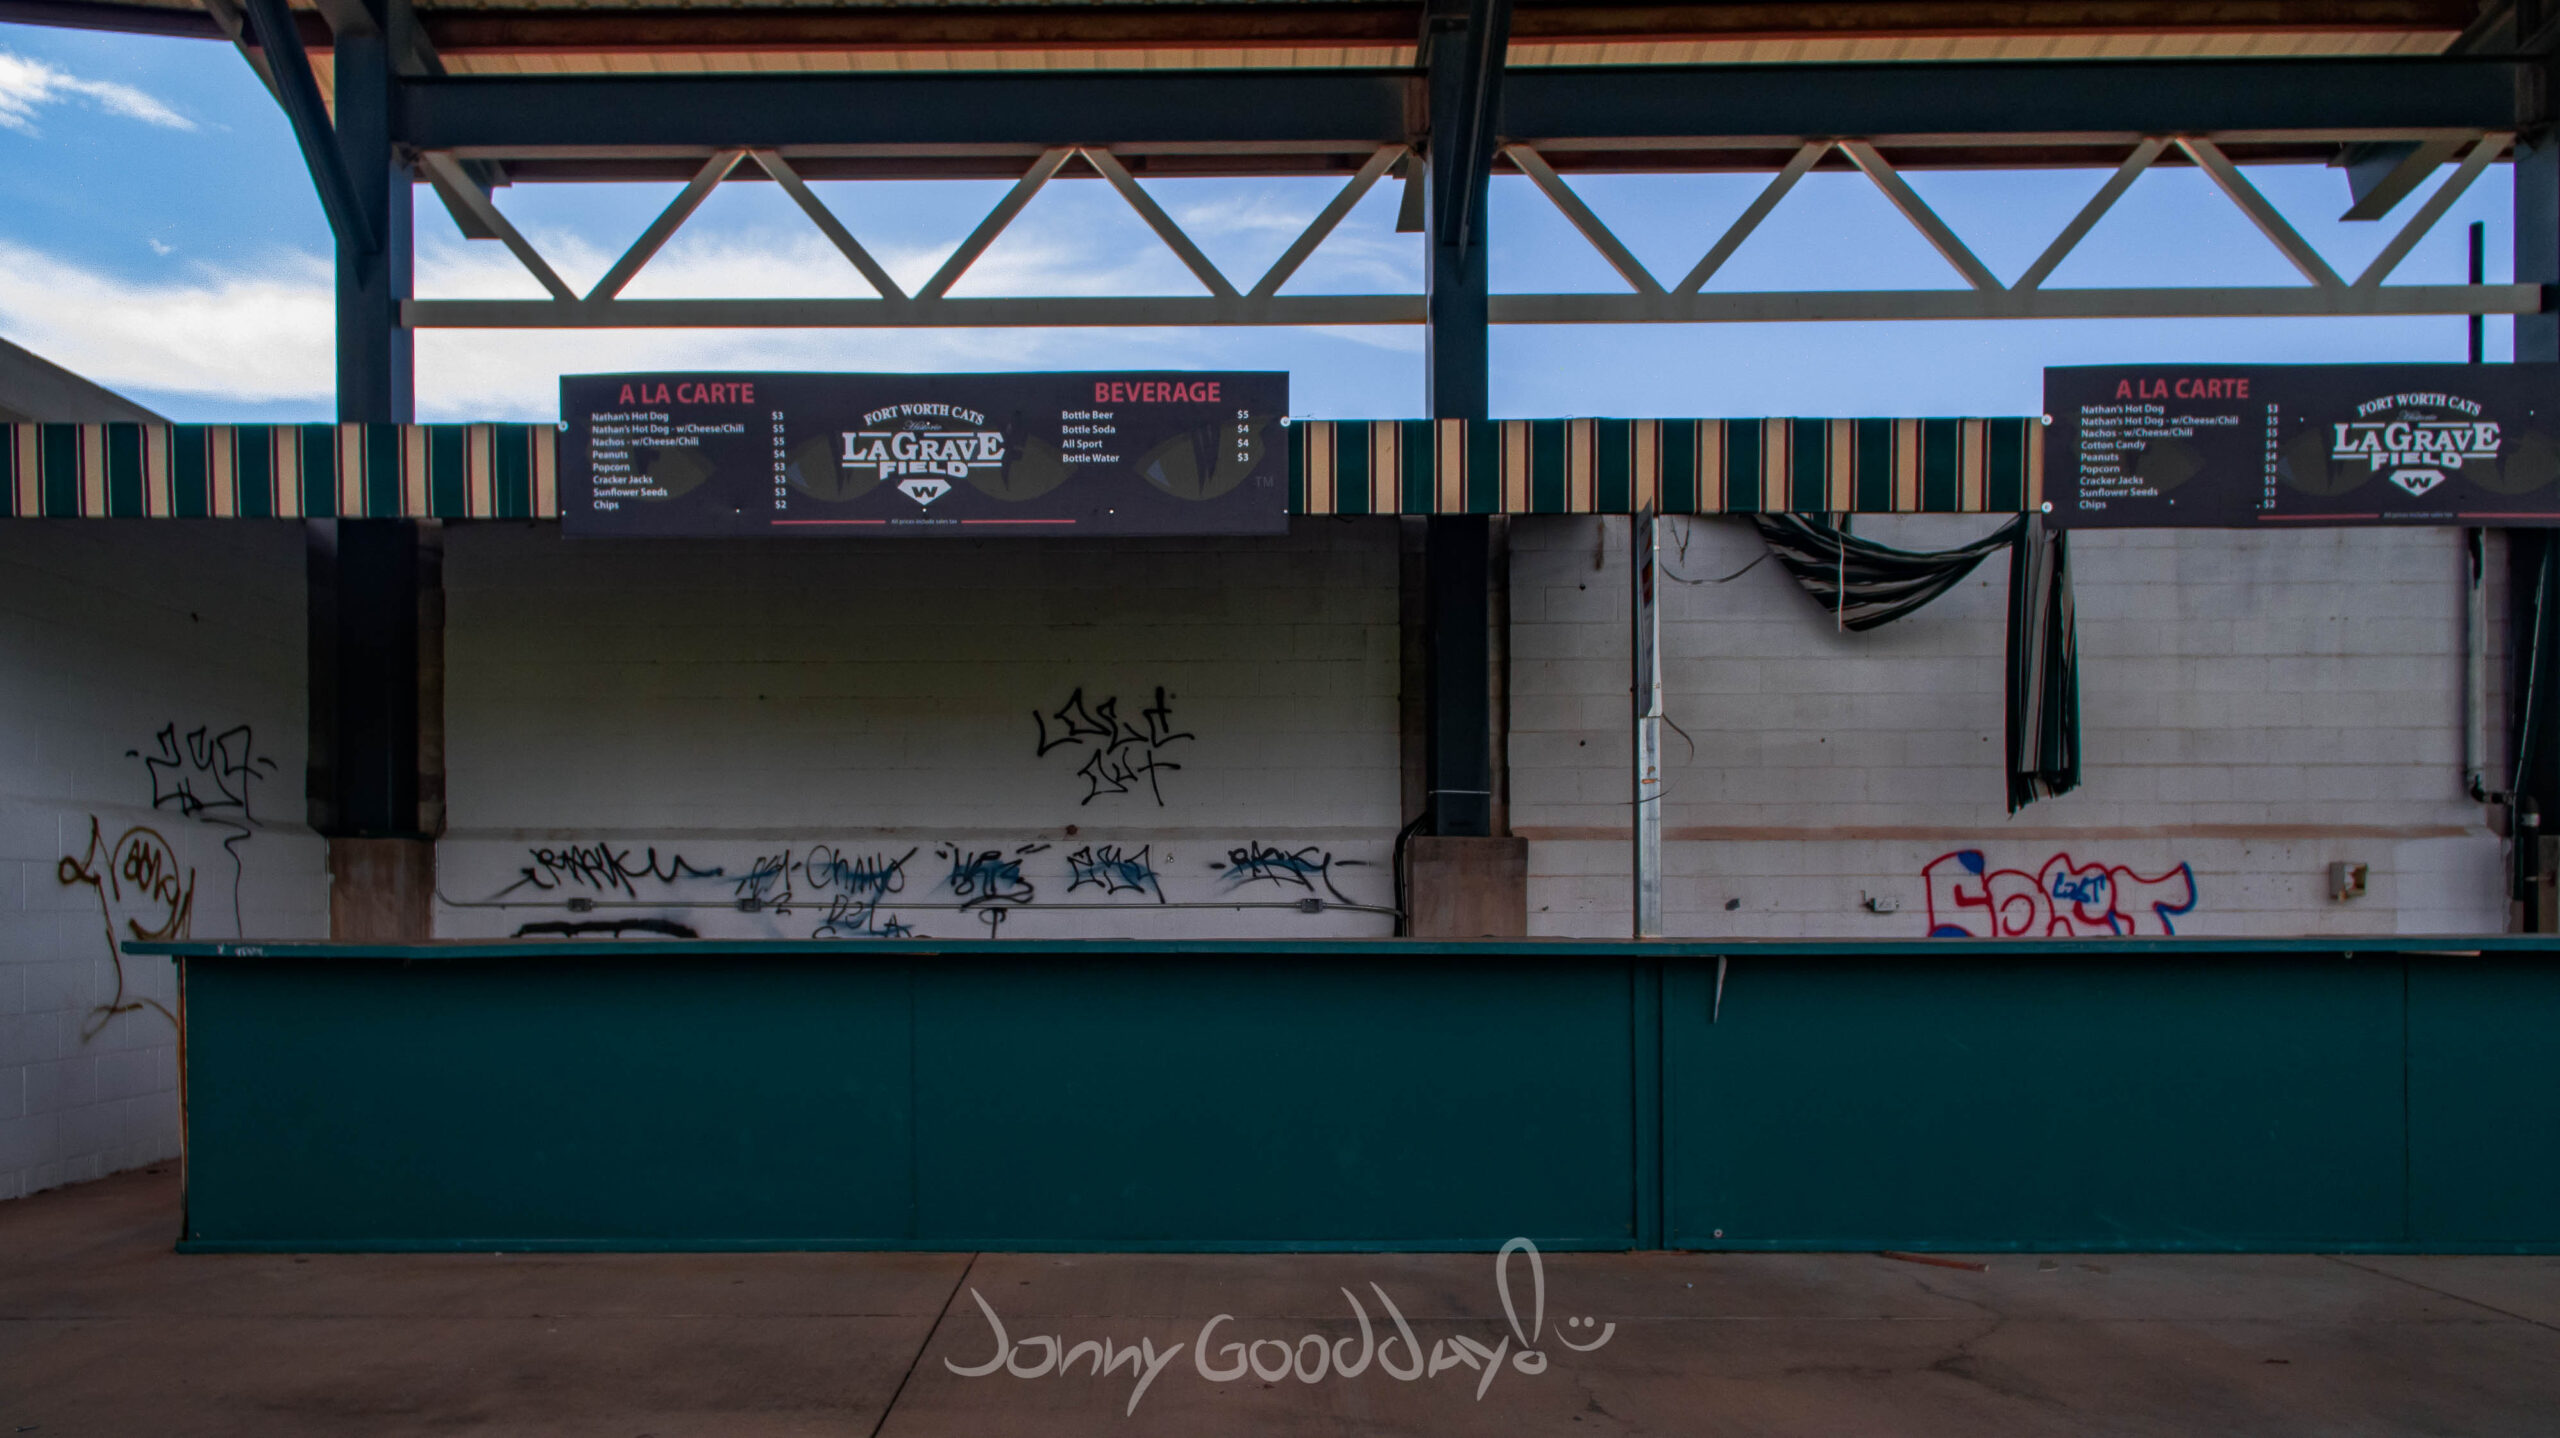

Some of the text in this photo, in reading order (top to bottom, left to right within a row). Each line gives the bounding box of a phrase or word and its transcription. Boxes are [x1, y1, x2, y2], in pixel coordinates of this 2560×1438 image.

[619, 382, 755, 404] A LA CARTE
[1096, 382, 1221, 402] BEVERAGE
[2116, 378, 2249, 399] A LA CARTE
[2081, 404, 2164, 415] Nathan's Hot Dog
[2267, 404, 2278, 413] $3
[2357, 393, 2482, 418] FORT WORTH CATS
[592, 413, 630, 421] Nathan's
[650, 412, 669, 422] Dog
[772, 411, 783, 420] $3
[863, 403, 984, 426] FORT WORTH CATS
[1063, 411, 1113, 419] Bottle Beer
[1238, 410, 1248, 419] $5
[2081, 418, 2122, 426] Nathan's
[2125, 417, 2142, 425] Hot
[2144, 416, 2164, 427] Dog
[2267, 416, 2278, 425] $5
[592, 426, 630, 434] Nathan's
[632, 425, 648, 433] Hot
[650, 424, 669, 435] Dog
[677, 424, 744, 433] w/Cheese/Chili
[773, 424, 784, 433] $5
[1063, 425, 1115, 434] Bottle Soda
[1238, 424, 1248, 433] $4
[2081, 429, 2116, 437] Nachos
[2267, 428, 2278, 437] $5
[592, 438, 625, 446] Nachos
[632, 437, 699, 446] w/Cheese/Chili
[773, 437, 784, 446] $5
[1063, 440, 1102, 450] All Sport
[1238, 438, 1248, 447] $4
[2081, 440, 2145, 450] Cotton Candy
[2266, 440, 2277, 449] $4
[593, 451, 628, 459] Peanuts
[774, 450, 785, 458] $4
[1063, 454, 1119, 462] Bottle Water
[1238, 453, 1248, 461] $3
[2081, 453, 2119, 461] Peanuts
[2266, 452, 2277, 461] $4
[2371, 452, 2463, 471] FIELD
[593, 463, 630, 473] Popcorn
[775, 463, 785, 471] $3
[879, 461, 968, 480] FIELD
[2080, 465, 2120, 475] Popcorn
[2265, 464, 2277, 472] $3
[593, 475, 653, 484] Cracker Jacks
[775, 475, 786, 484] $3
[2080, 476, 2143, 485] Cracker Jacks
[2265, 476, 2276, 485] $3
[594, 488, 667, 497] Sunflower Seeds
[775, 488, 786, 496] $3
[2080, 488, 2158, 497] Sunflower Seeds
[2264, 488, 2275, 496] $3
[594, 501, 619, 511] Chips
[776, 500, 786, 509] $2
[2079, 500, 2106, 510] Chips
[2264, 499, 2275, 508] $2
